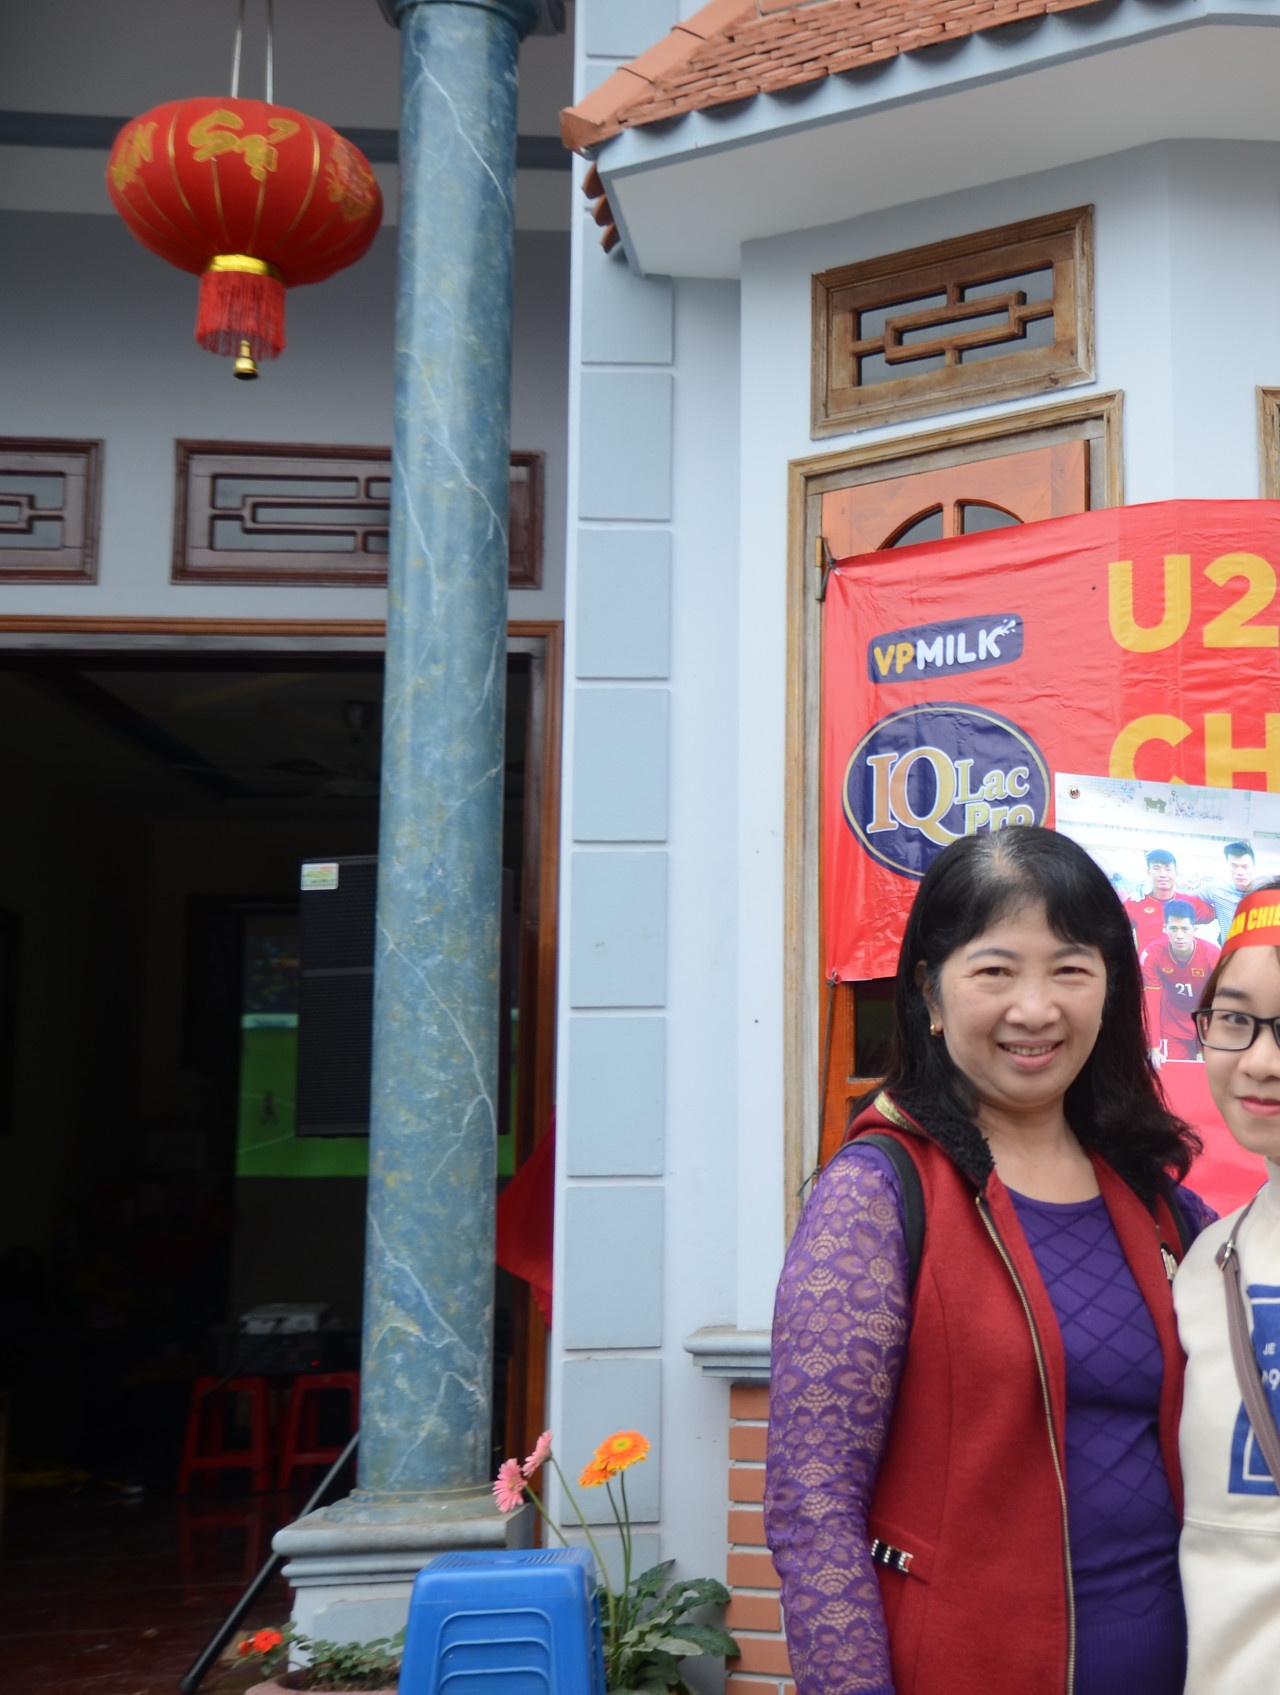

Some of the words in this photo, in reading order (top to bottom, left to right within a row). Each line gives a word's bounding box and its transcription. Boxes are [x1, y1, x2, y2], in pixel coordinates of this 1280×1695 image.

[873, 622, 1008, 677] VPMILK
[1226, 911, 1247, 941] AM
[1175, 983, 1194, 997] 21
